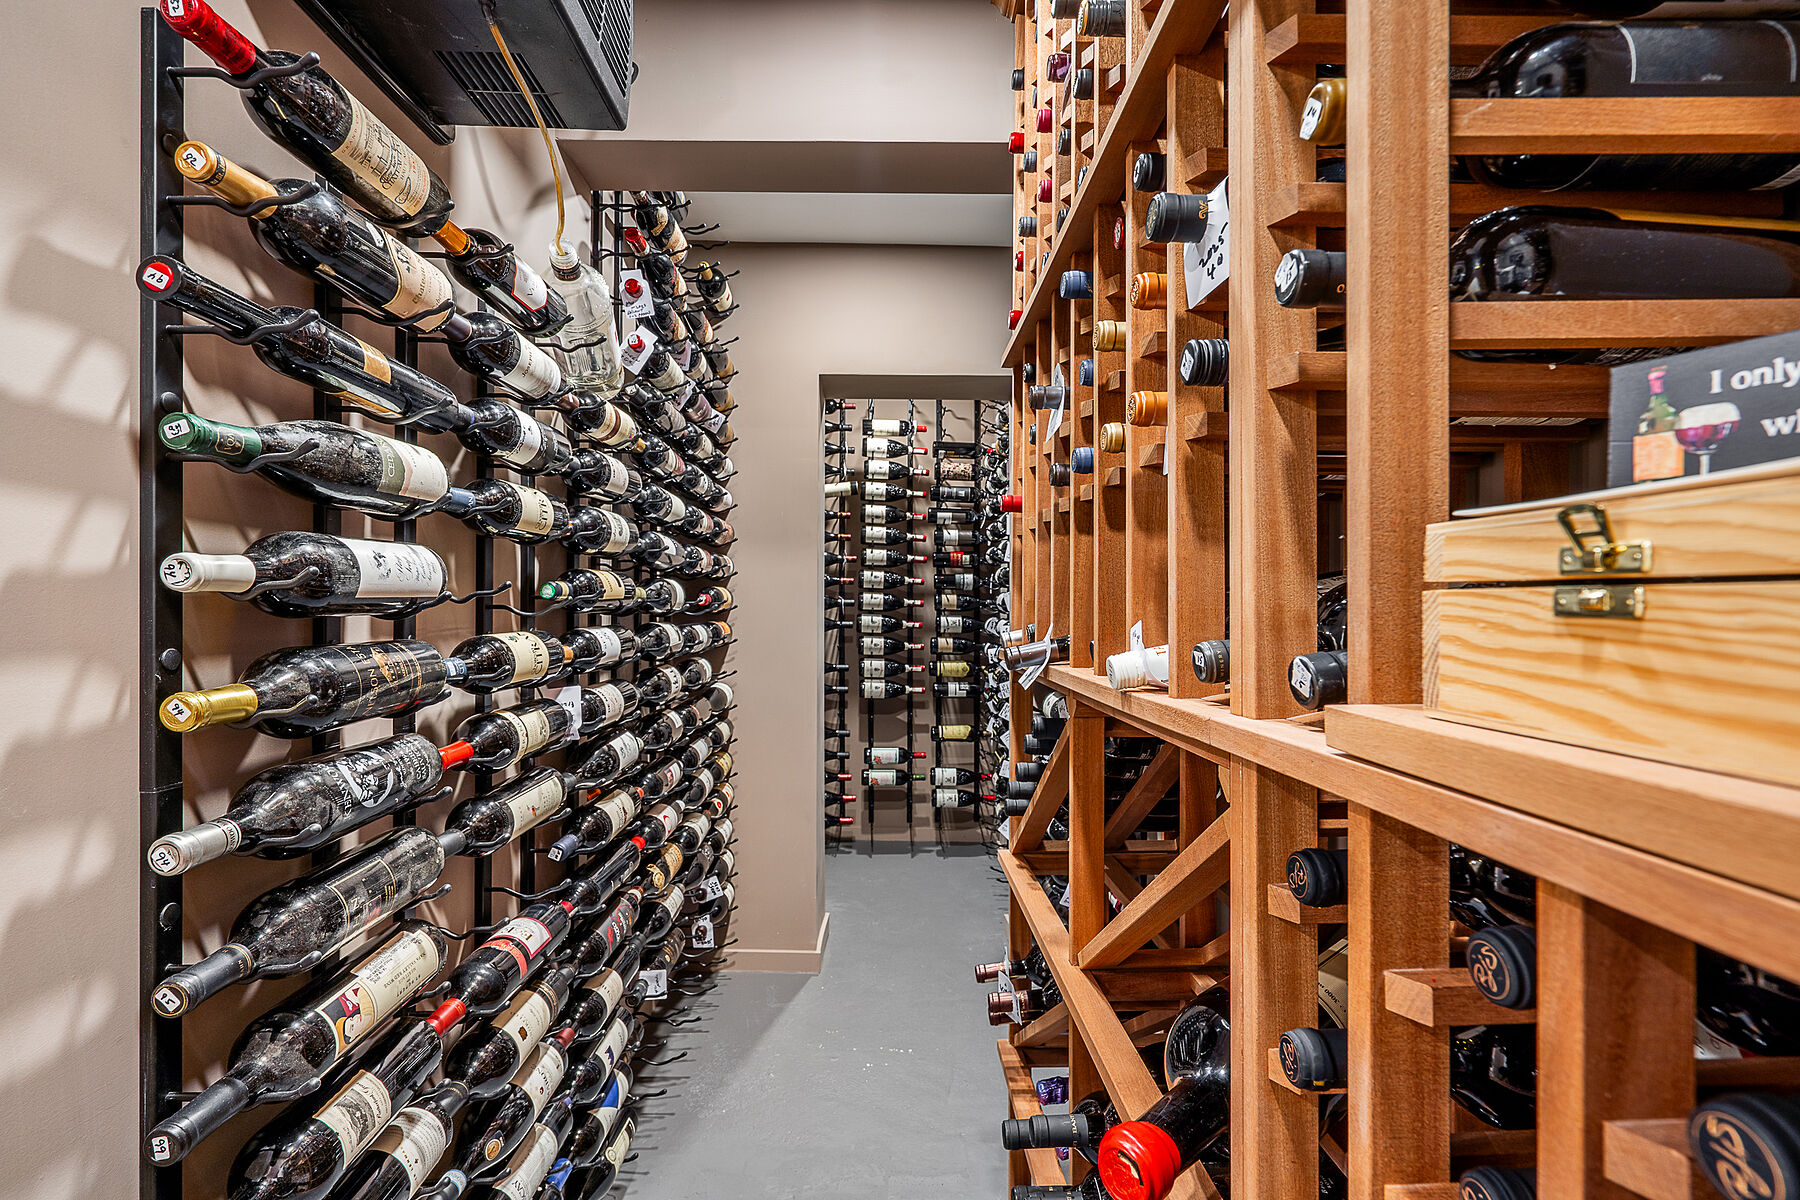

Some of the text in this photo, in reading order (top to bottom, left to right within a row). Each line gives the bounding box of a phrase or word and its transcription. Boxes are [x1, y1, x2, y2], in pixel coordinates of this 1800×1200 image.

[185, 152, 198, 168] 92
[1709, 369, 1723, 394] I
[171, 702, 185, 717] 94
[157, 851, 172, 867] 94
[154, 1138, 166, 1155] 99
